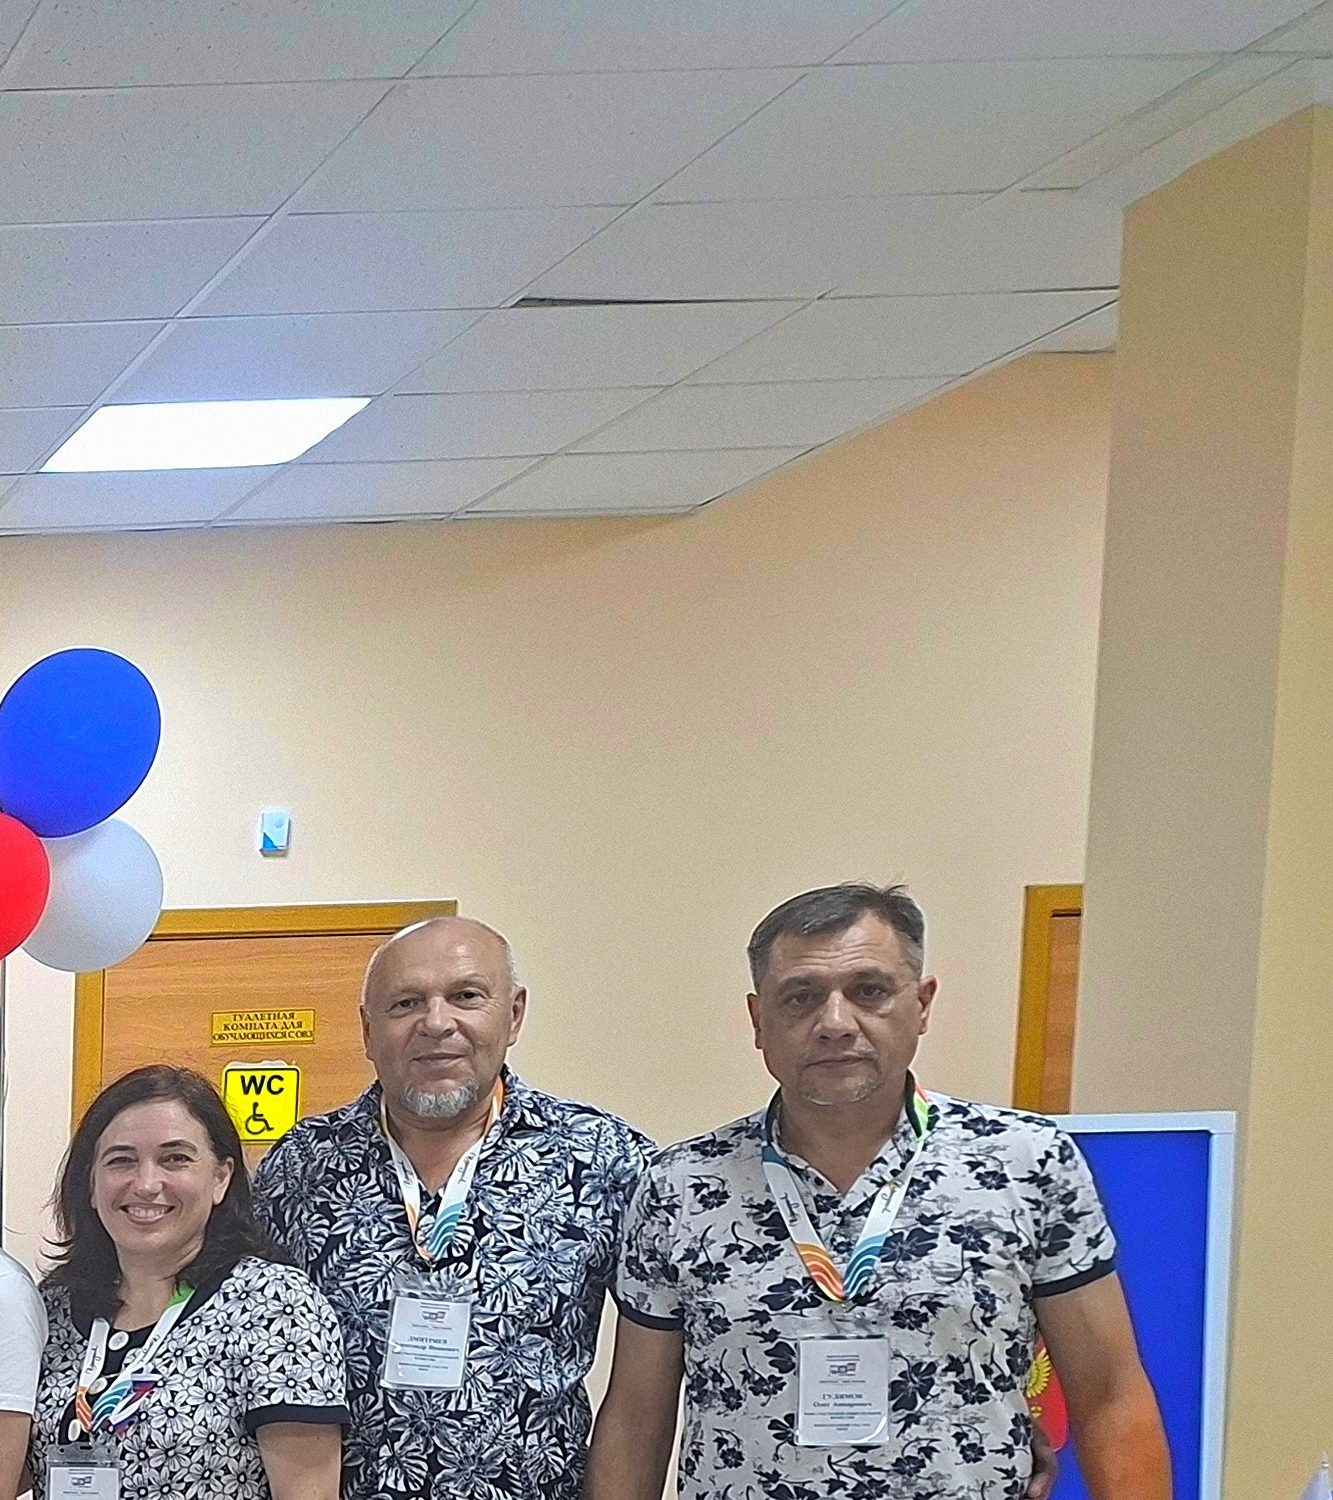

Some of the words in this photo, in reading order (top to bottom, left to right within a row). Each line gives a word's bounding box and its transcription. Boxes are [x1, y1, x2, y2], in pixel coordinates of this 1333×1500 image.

[233, 1012, 295, 1021] ТУАЛЕТНАЯ
[224, 1021, 278, 1031] КОМНАТА
[281, 1020, 303, 1030] ДЛЯ
[213, 1031, 287, 1041] ОБУЧАЮЩИХСЯ
[288, 1031, 294, 1039] С
[295, 1030, 313, 1039] ОВЗ
[240, 1074, 284, 1095] WC
